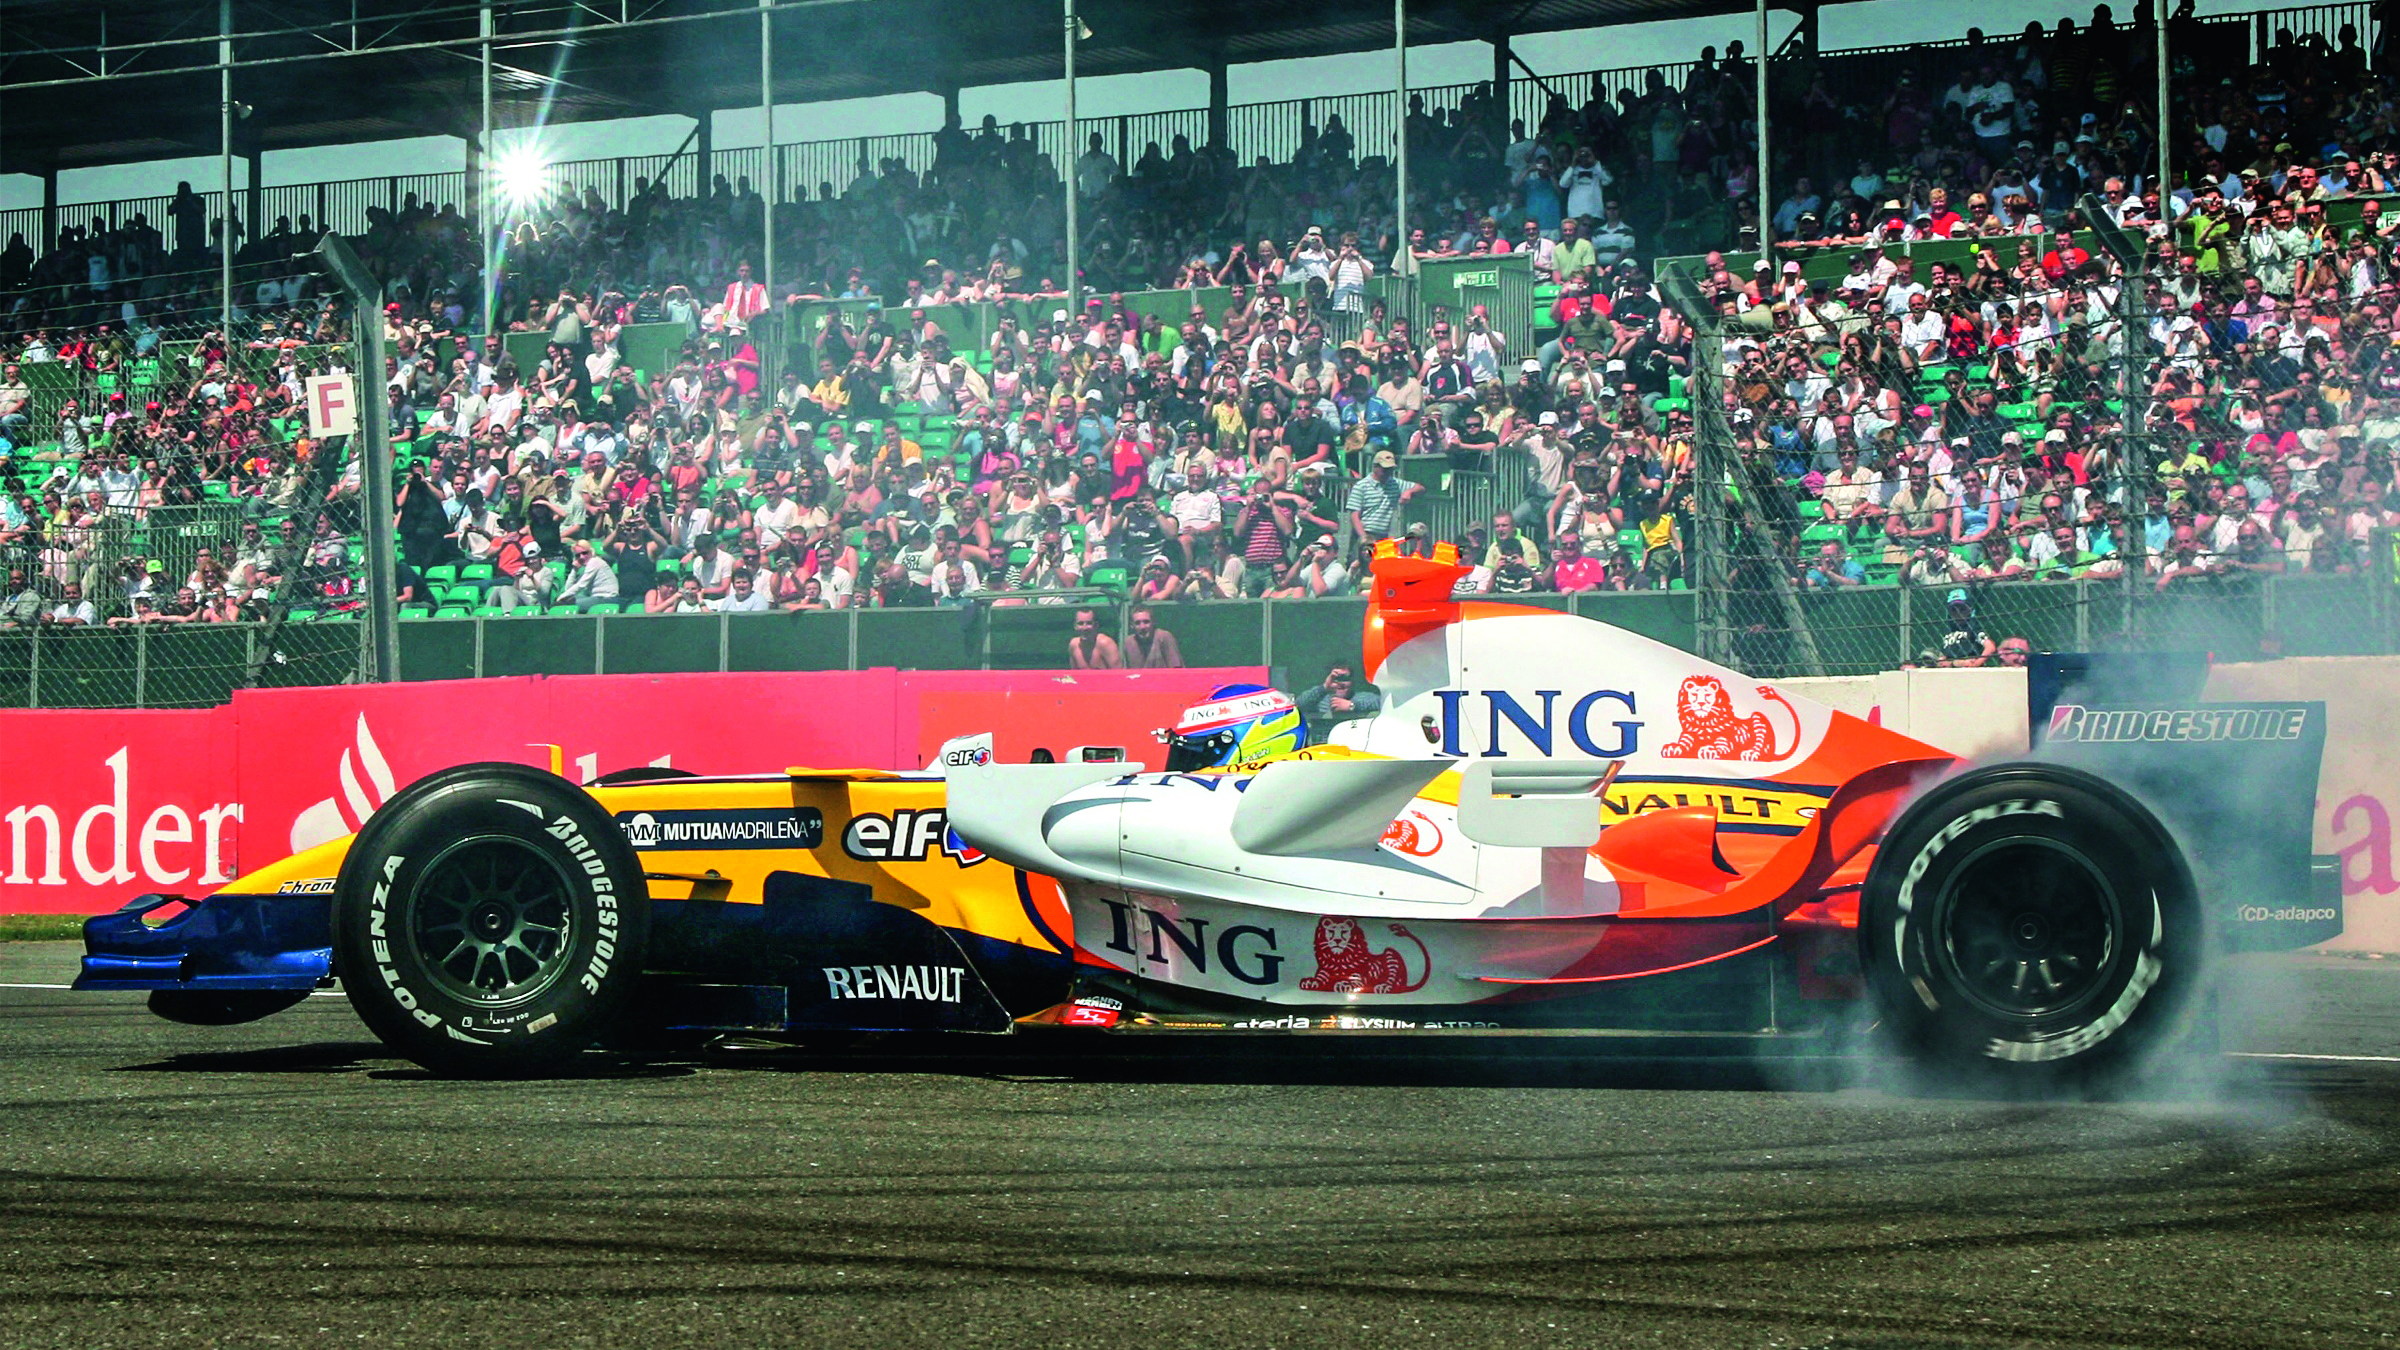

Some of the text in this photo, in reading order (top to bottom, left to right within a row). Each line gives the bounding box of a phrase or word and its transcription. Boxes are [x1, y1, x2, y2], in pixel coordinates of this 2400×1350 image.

[318, 382, 344, 428] F
[1191, 708, 1215, 721] ING
[1243, 698, 1272, 710] ING
[1433, 689, 1645, 758] ING
[2045, 704, 2306, 742] BRIDGESTONE
[946, 750, 974, 766] elf
[0, 746, 244, 886] nder
[1603, 794, 1781, 818] NAULT
[845, 811, 944, 858] elf
[278, 880, 336, 894] Chron
[544, 815, 619, 996] BRIDGESTONE
[2243, 906, 2337, 923] CD-adapco
[370, 855, 442, 1029] POTENZA
[1100, 897, 1286, 986] ING
[822, 964, 965, 1004] RENAULT
[1233, 1014, 1310, 1029] steria
